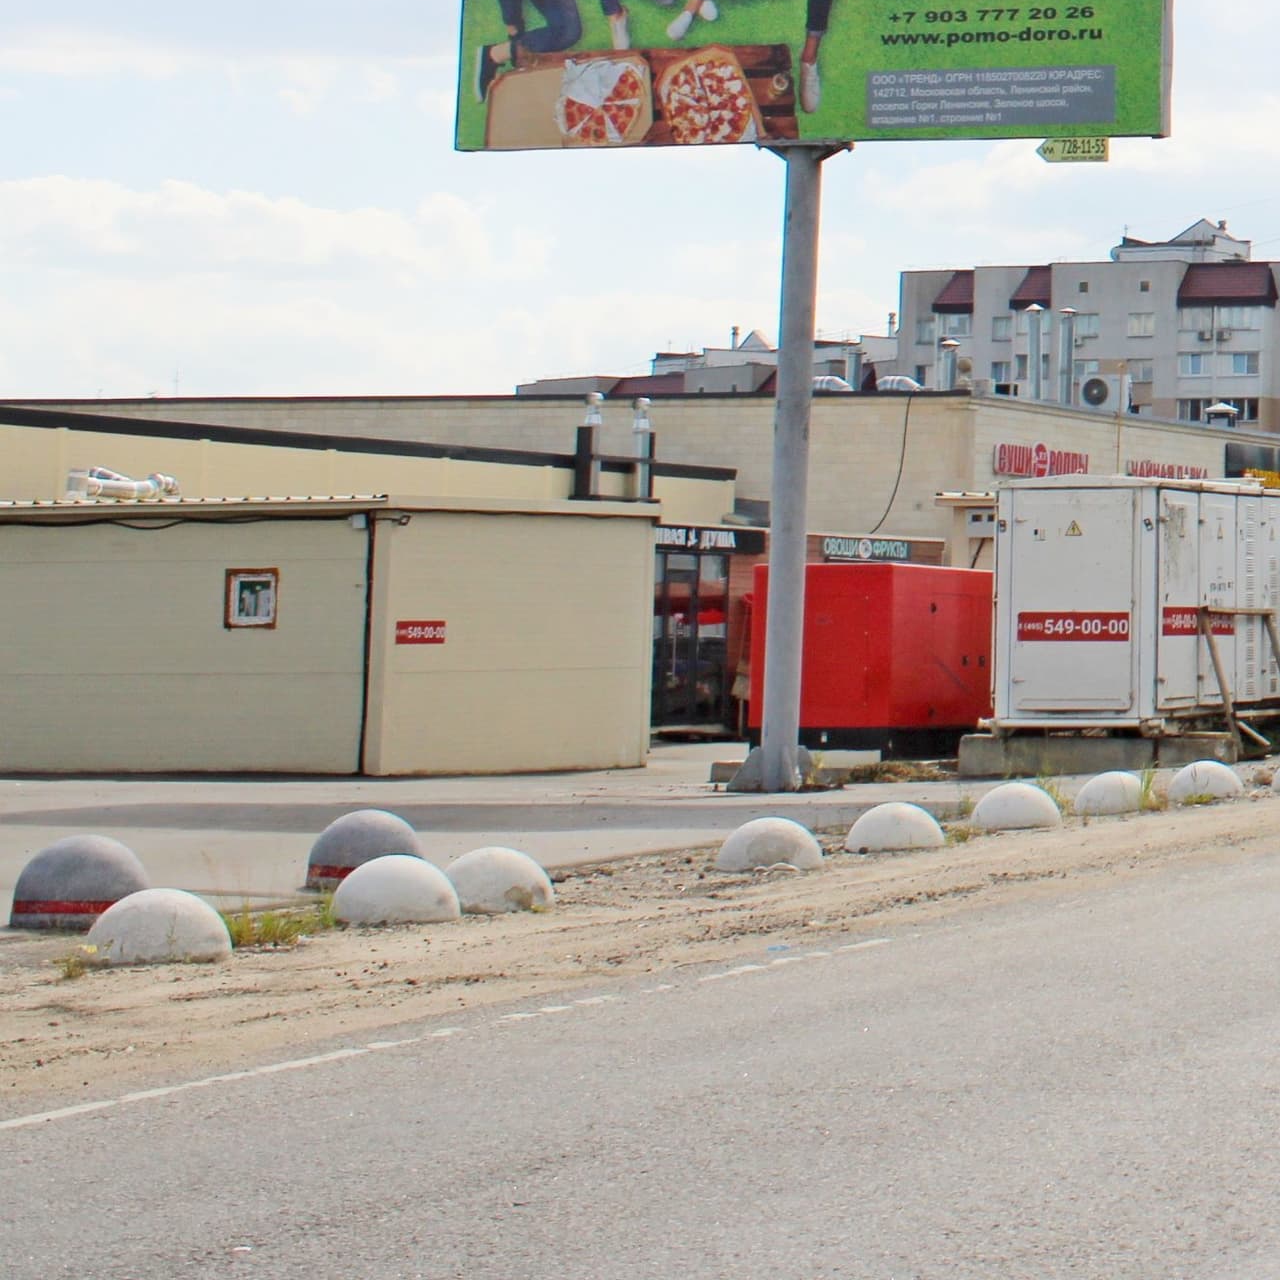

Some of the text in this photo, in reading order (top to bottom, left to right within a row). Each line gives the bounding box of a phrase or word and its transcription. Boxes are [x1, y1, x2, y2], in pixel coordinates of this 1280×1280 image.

[889, 6, 1095, 24] +7 903 777 20 26
[881, 27, 1103, 47] www.pomo-doro.ru
[824, 538, 908, 558] ОВОЩИ ФРУКТЫ
[1044, 619, 1128, 634] 549-00-00
